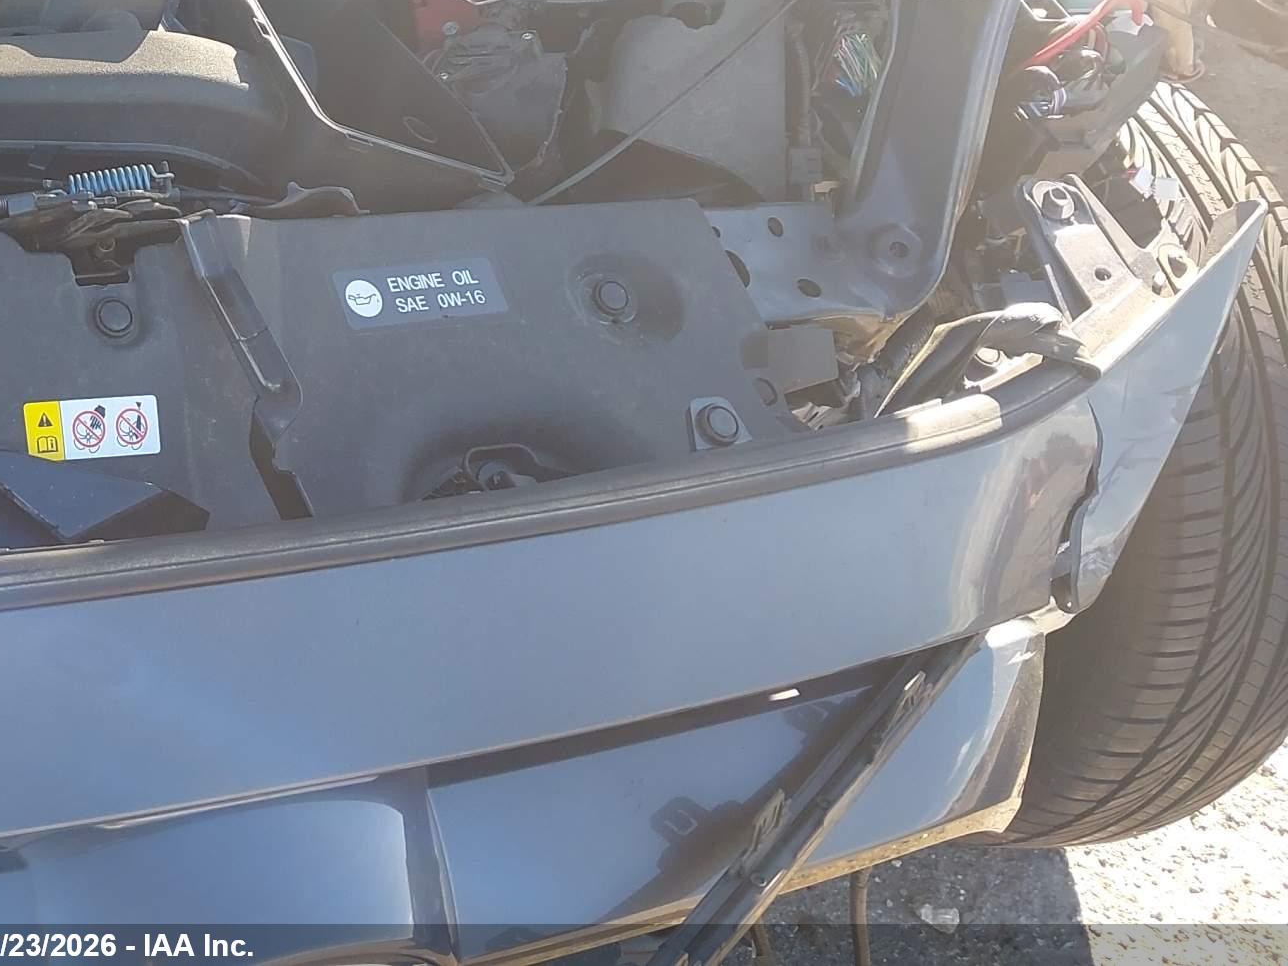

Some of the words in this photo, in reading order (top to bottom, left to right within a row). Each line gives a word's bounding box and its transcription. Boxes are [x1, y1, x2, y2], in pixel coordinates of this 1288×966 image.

[387, 272, 445, 292] ENGINE
[452, 269, 479, 286] OIL
[395, 295, 429, 313] SAE
[437, 289, 486, 308] 0W-16
